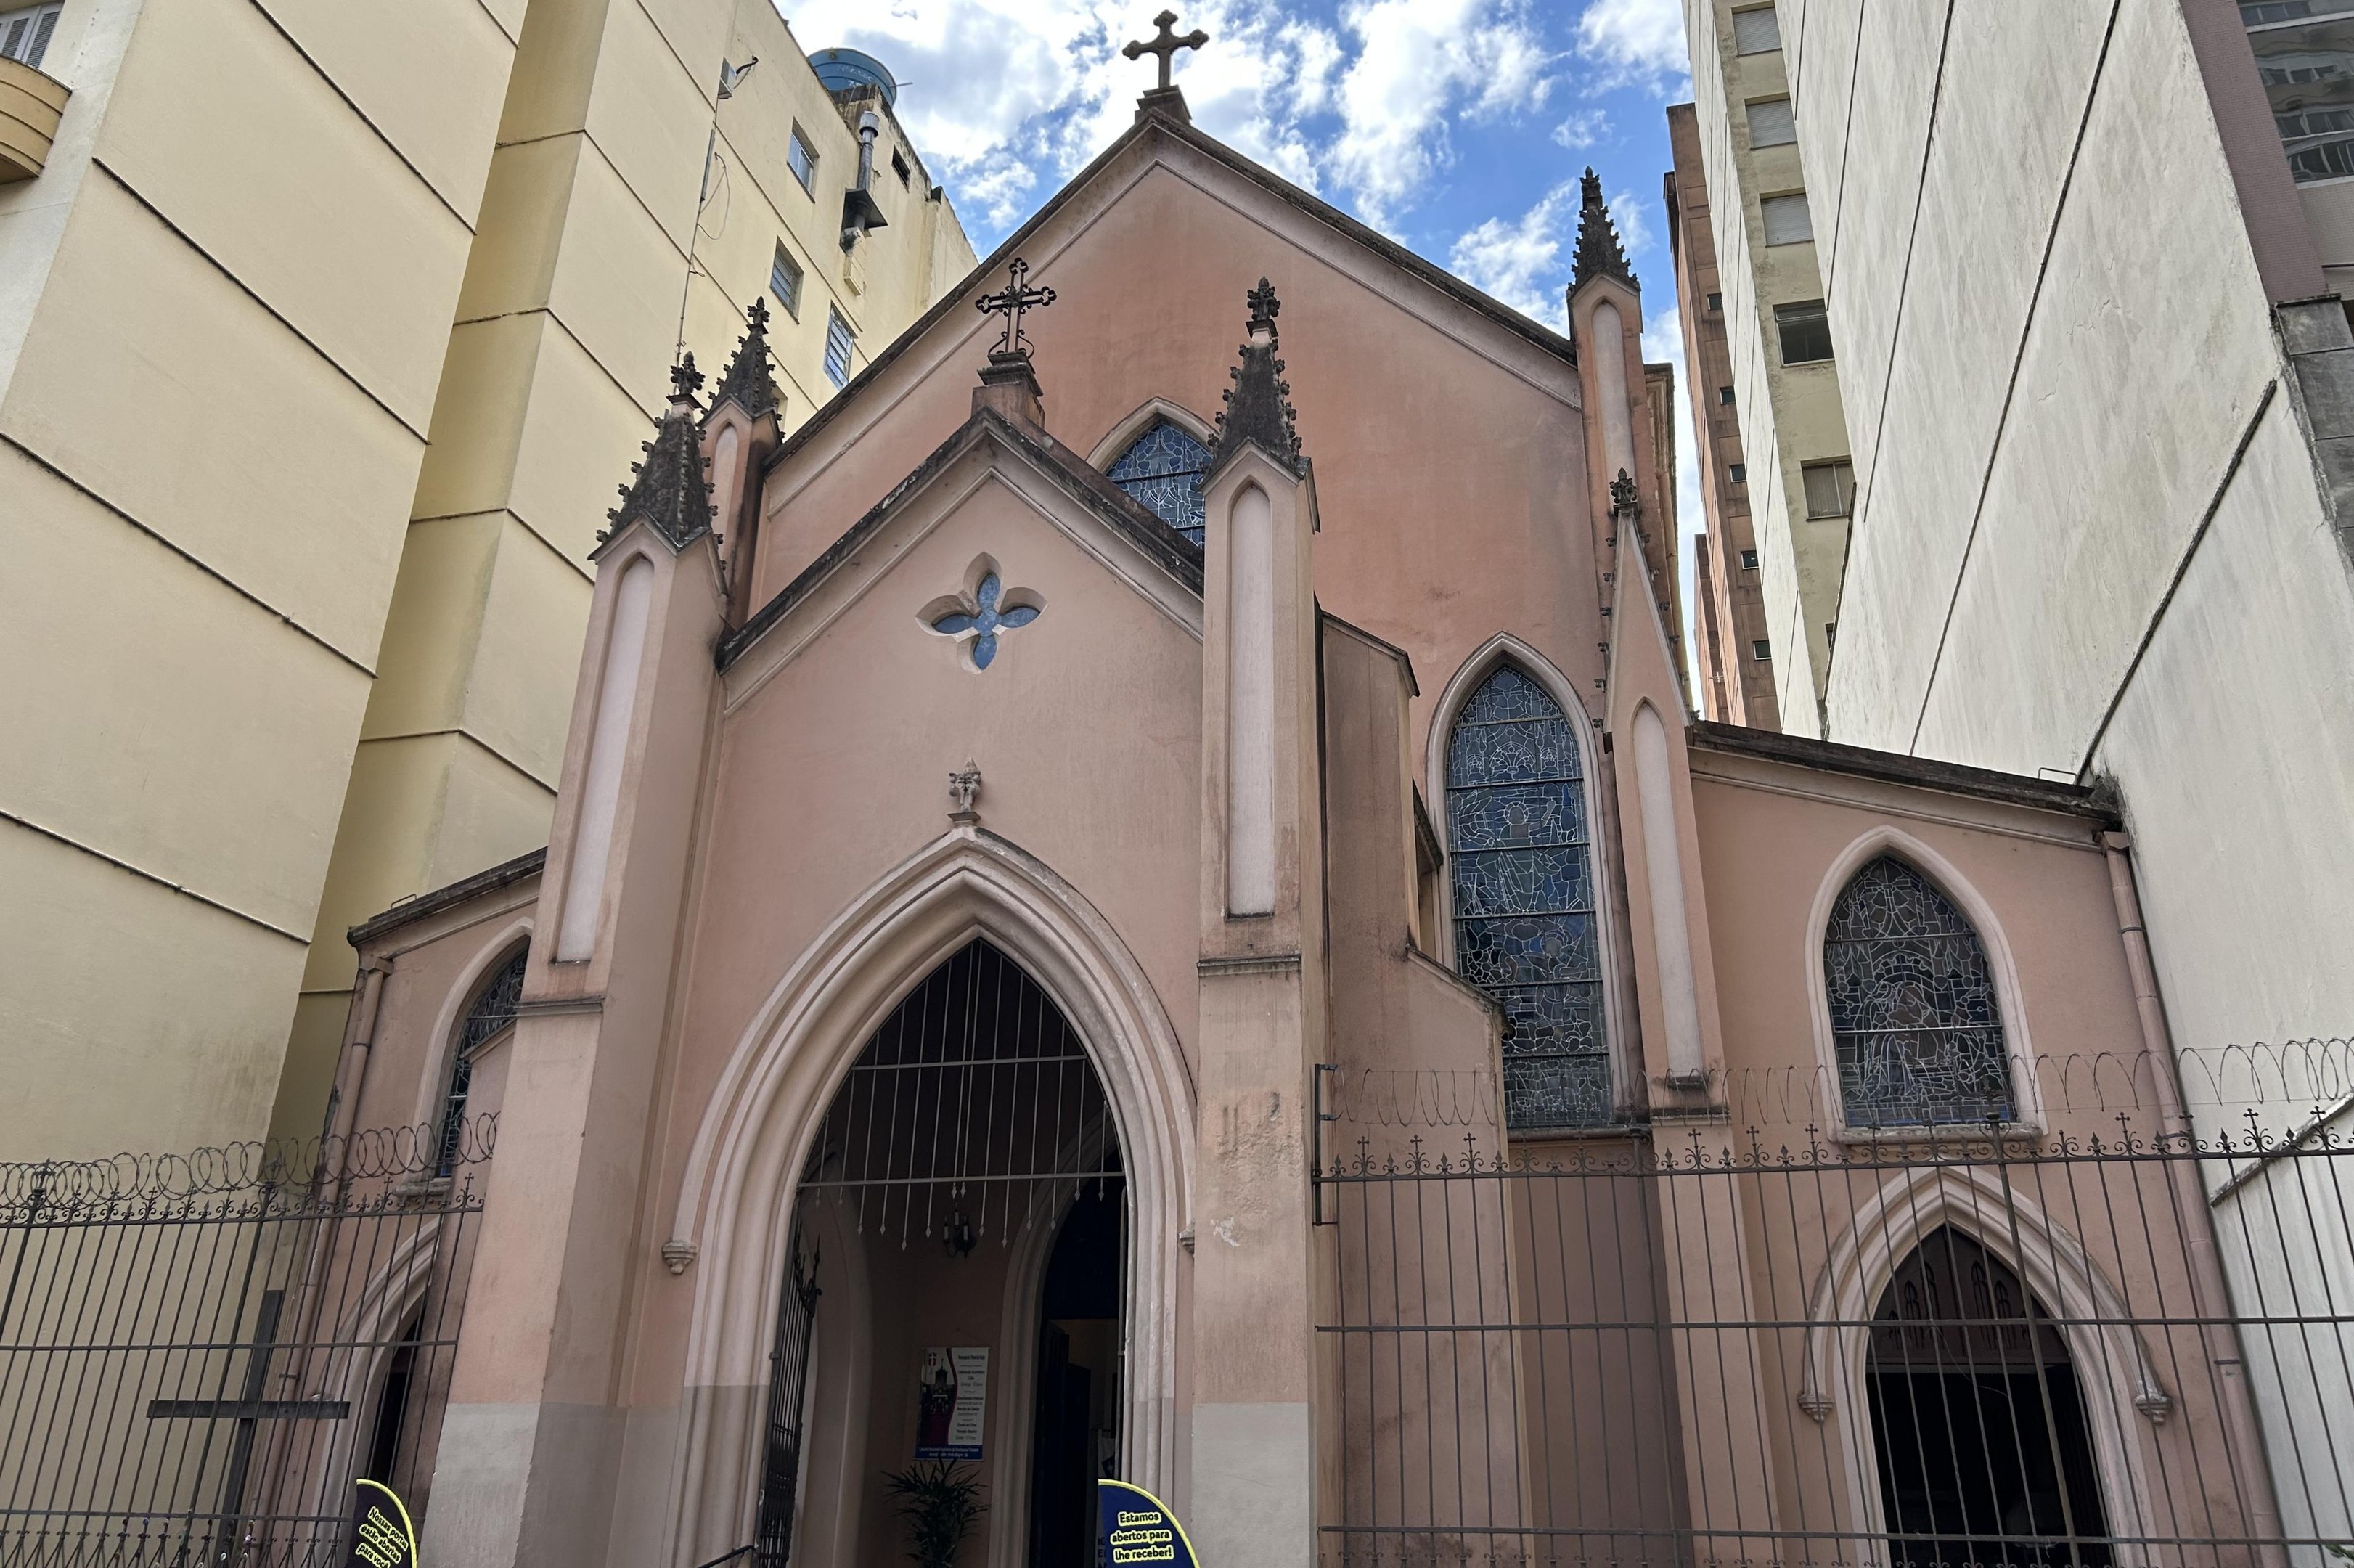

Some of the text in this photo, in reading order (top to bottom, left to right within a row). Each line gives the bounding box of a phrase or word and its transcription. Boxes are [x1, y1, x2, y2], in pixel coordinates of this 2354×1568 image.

[1119, 1513, 1159, 1524] Estamos
[369, 1508, 407, 1548] Nossas portas
[1112, 1530, 1147, 1542] abertos
[1149, 1531, 1169, 1541] para
[361, 1526, 400, 1561] estão abertas
[357, 1545, 374, 1559] para
[1115, 1550, 1130, 1561] lhe
[1132, 1547, 1172, 1559] receber!
